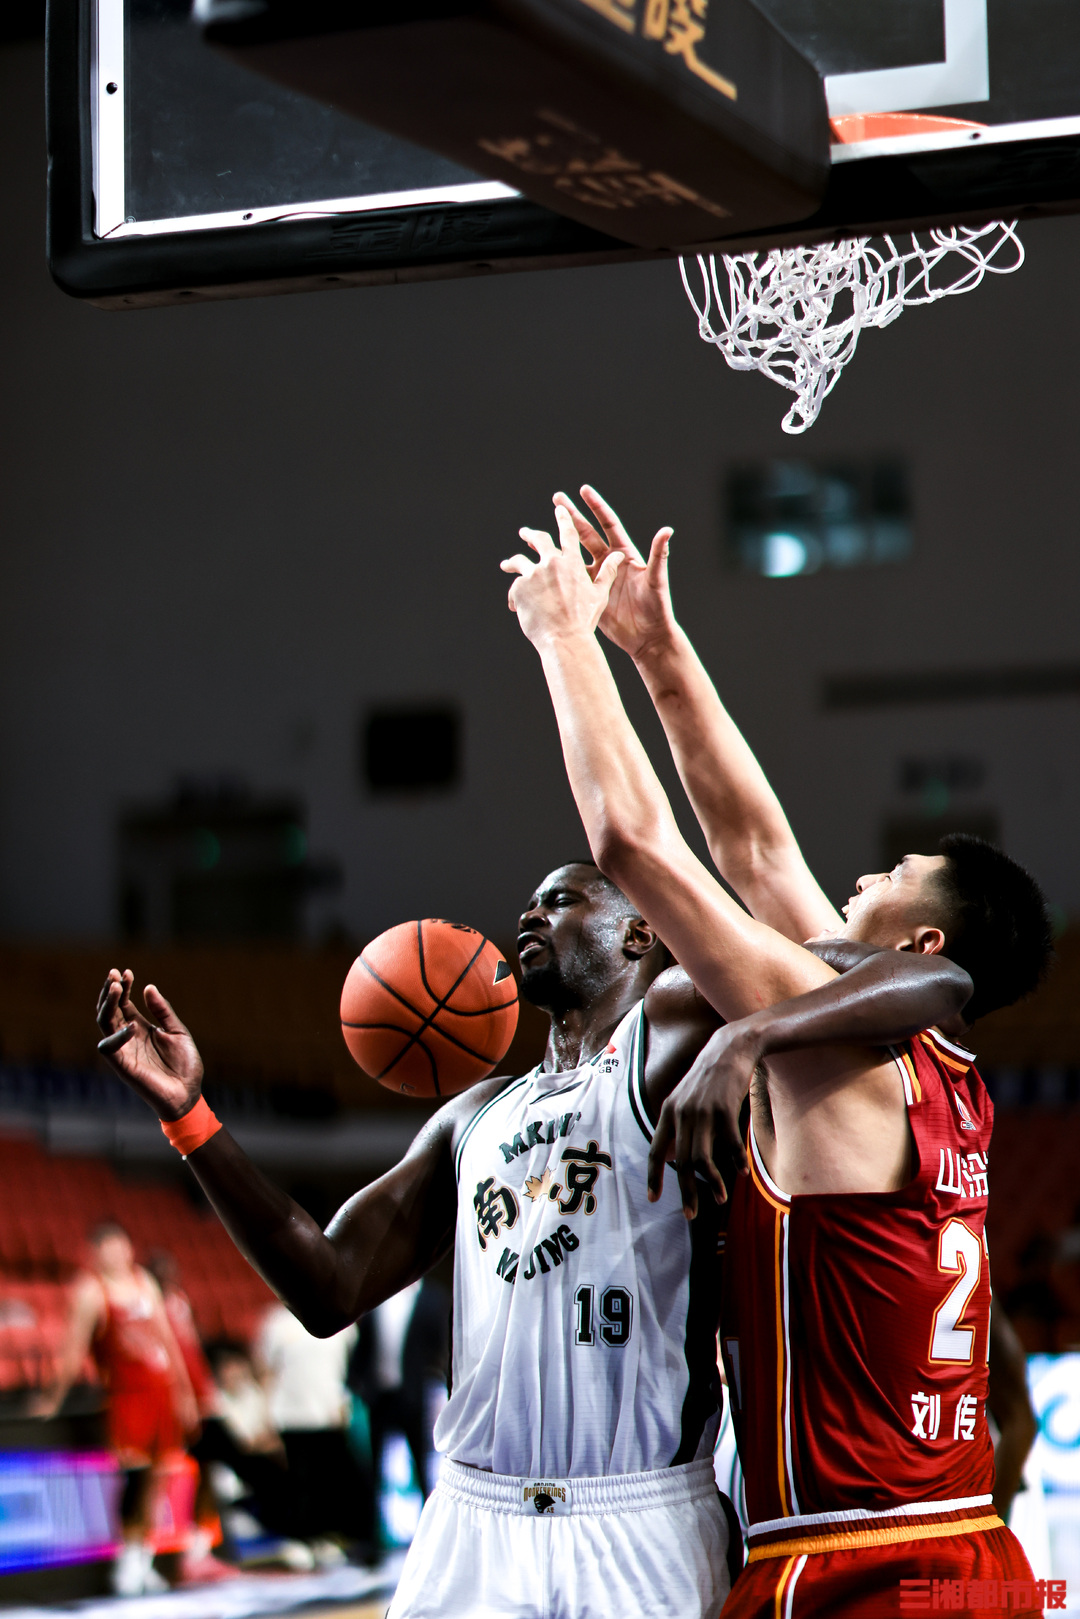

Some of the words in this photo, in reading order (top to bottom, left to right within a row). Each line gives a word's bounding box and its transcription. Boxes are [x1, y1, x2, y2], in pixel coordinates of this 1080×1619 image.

[473, 1139, 612, 1252] 南京
[573, 1283, 634, 1348] 19
[928, 1216, 991, 1367] 2
[911, 1391, 987, 1441] 刘传
